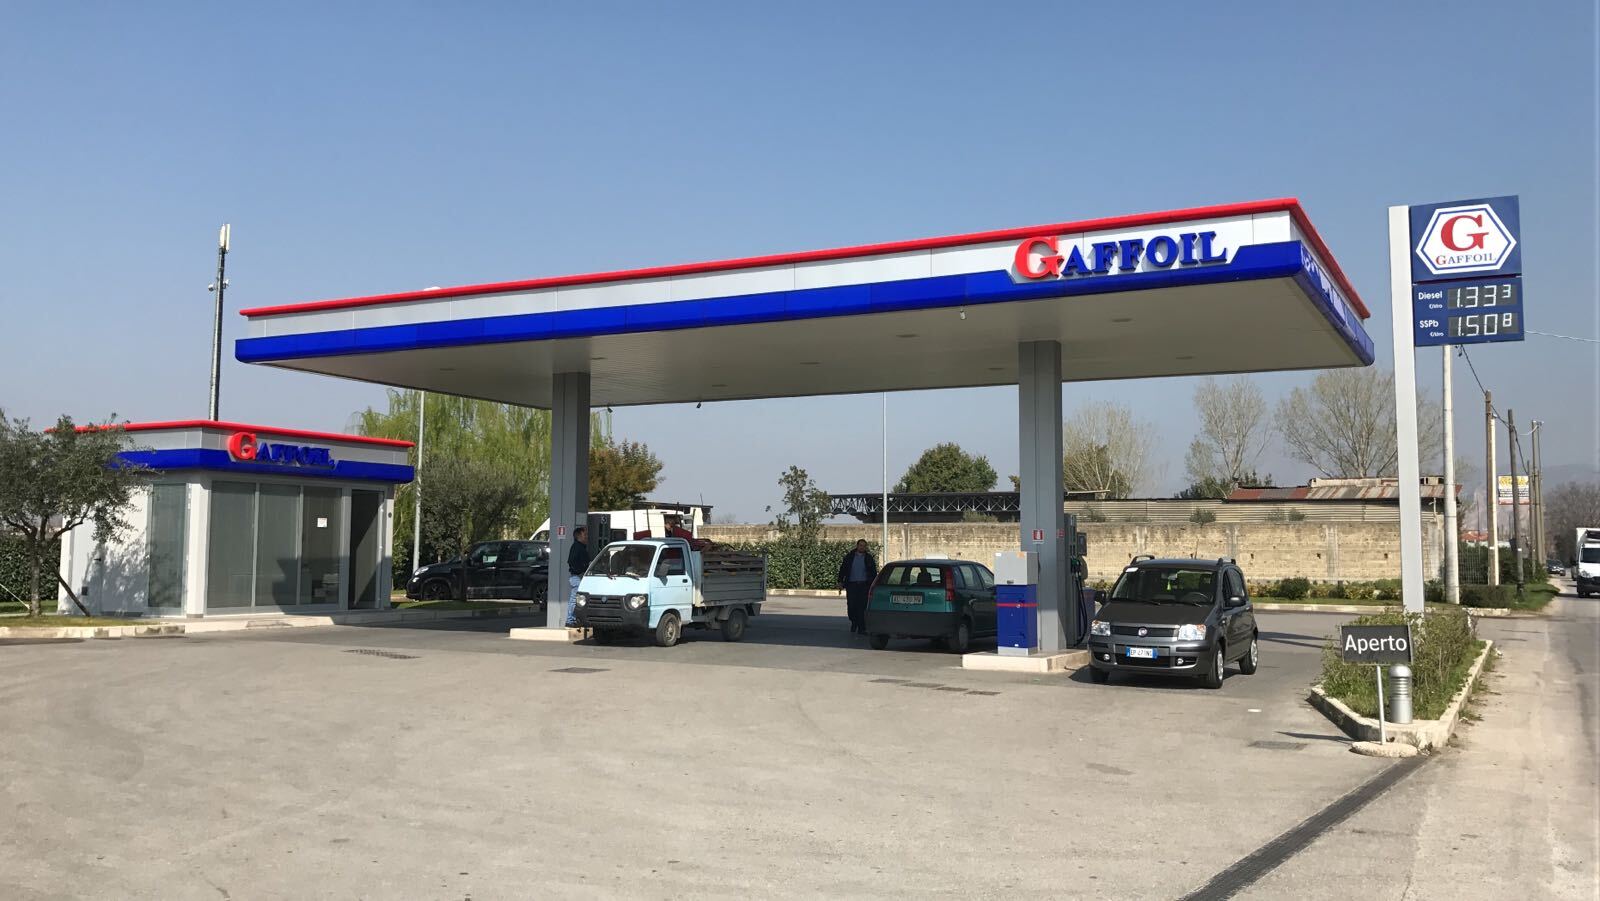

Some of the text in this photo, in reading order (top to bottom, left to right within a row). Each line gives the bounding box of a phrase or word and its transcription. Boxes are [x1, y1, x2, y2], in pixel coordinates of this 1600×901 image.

[1440, 215, 1489, 251] G
[1014, 231, 1227, 279] GAFFOIL
[1435, 253, 1496, 265] GAFFOIL
[1418, 290, 1443, 300] Diesel
[1419, 319, 1439, 329] SSPb
[1344, 634, 1408, 655] Aperto
